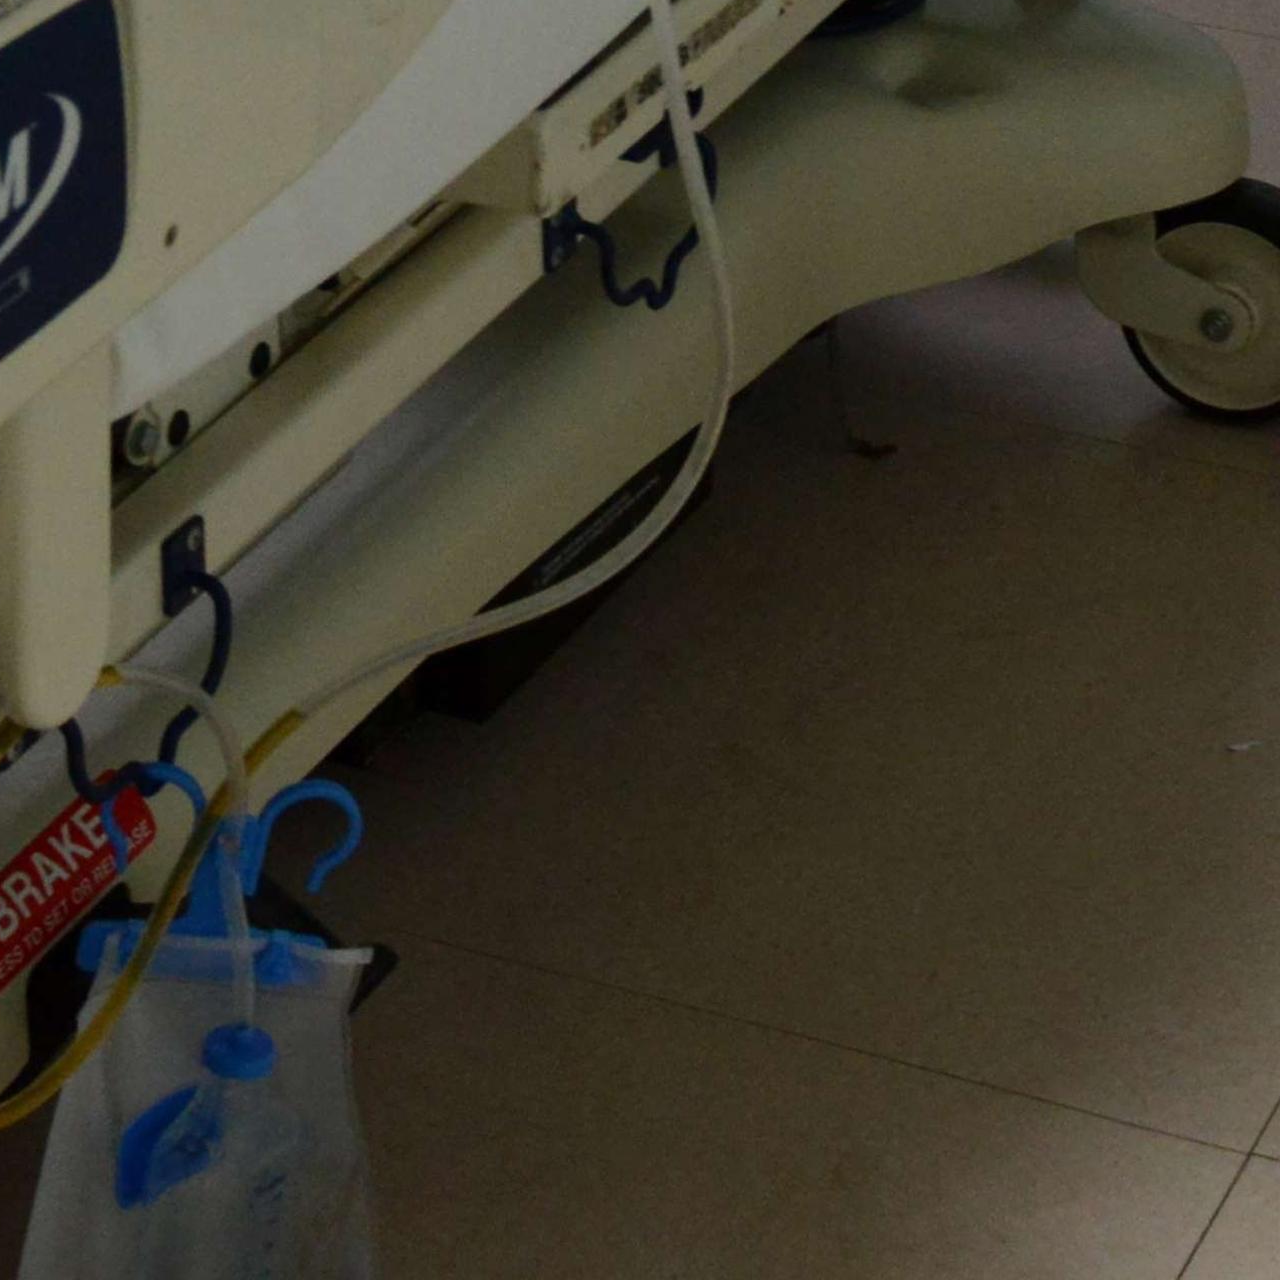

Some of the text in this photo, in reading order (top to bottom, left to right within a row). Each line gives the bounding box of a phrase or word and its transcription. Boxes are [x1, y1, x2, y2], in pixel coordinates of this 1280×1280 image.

[24, 925, 45, 948] TO
[42, 899, 71, 931] SET
[71, 877, 92, 905] OR
